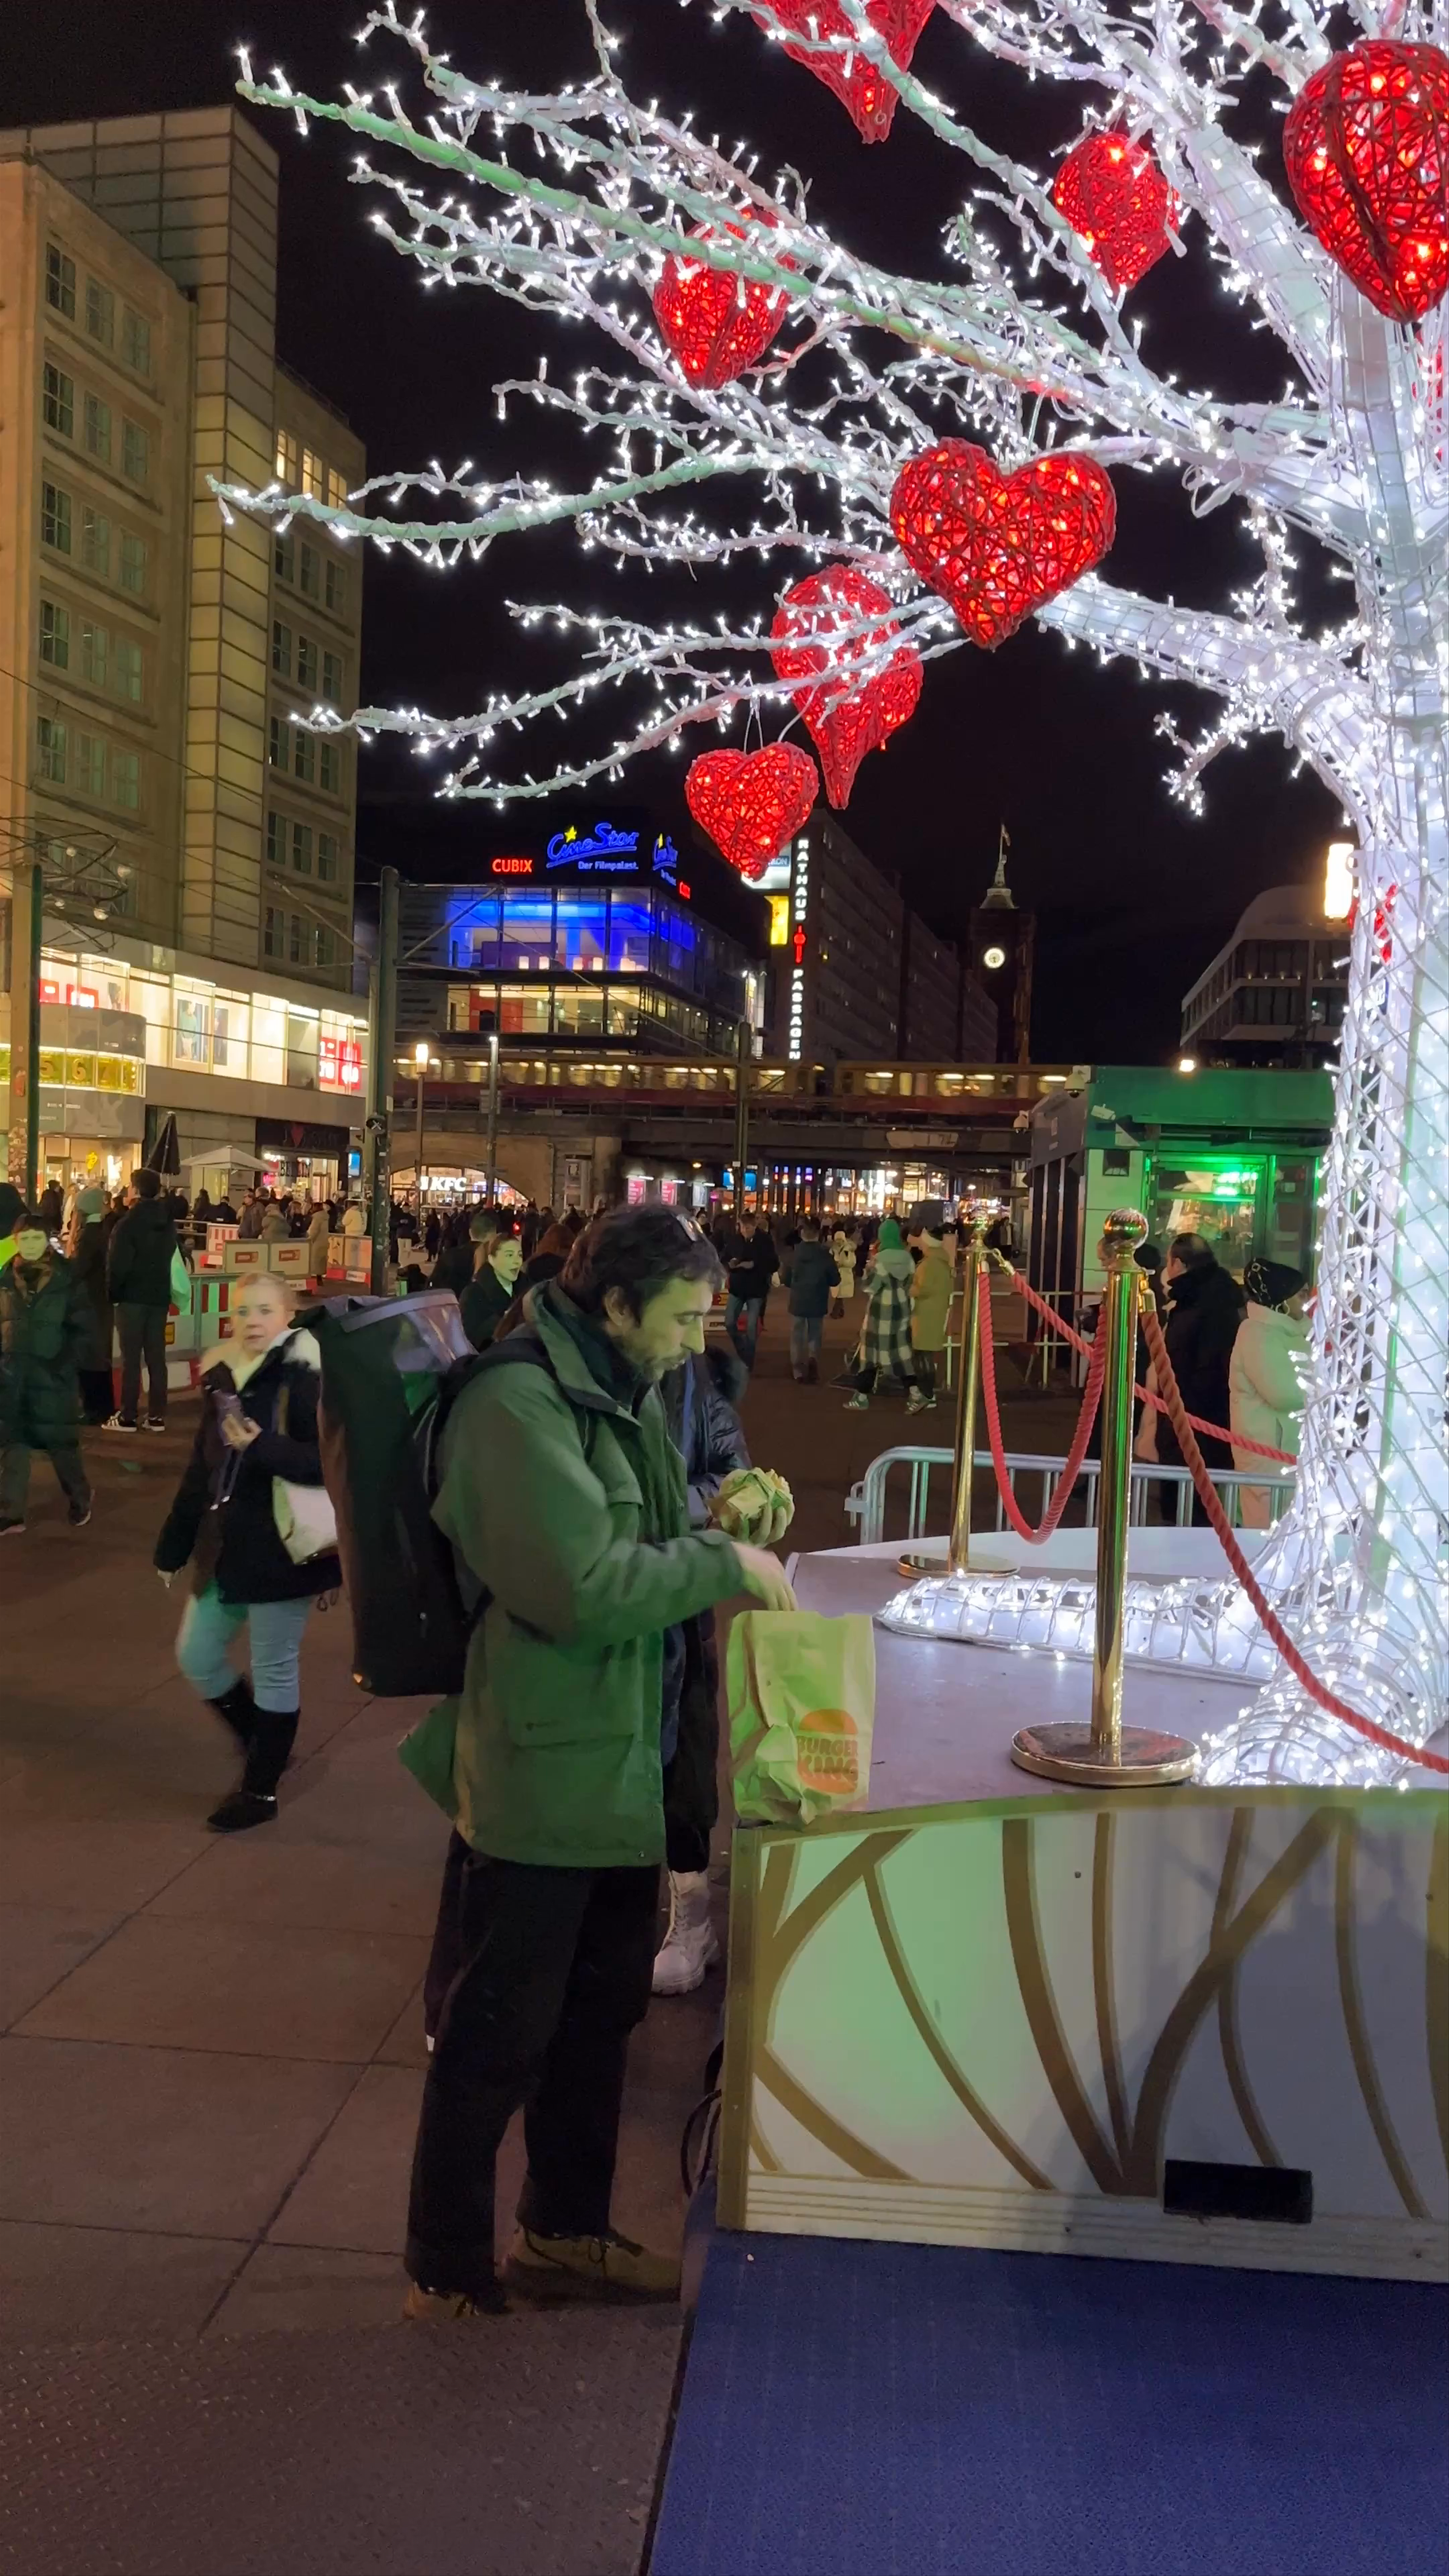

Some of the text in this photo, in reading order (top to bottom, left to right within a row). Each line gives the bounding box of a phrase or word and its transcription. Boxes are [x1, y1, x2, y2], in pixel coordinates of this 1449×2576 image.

[547, 823, 639, 860] CineStar
[492, 858, 532, 873] CUBIX
[795, 839, 809, 920] RATHAUS
[789, 969, 804, 1060] PASSAGEN
[72, 1058, 86, 1080] 6
[430, 1176, 466, 1191] KFC
